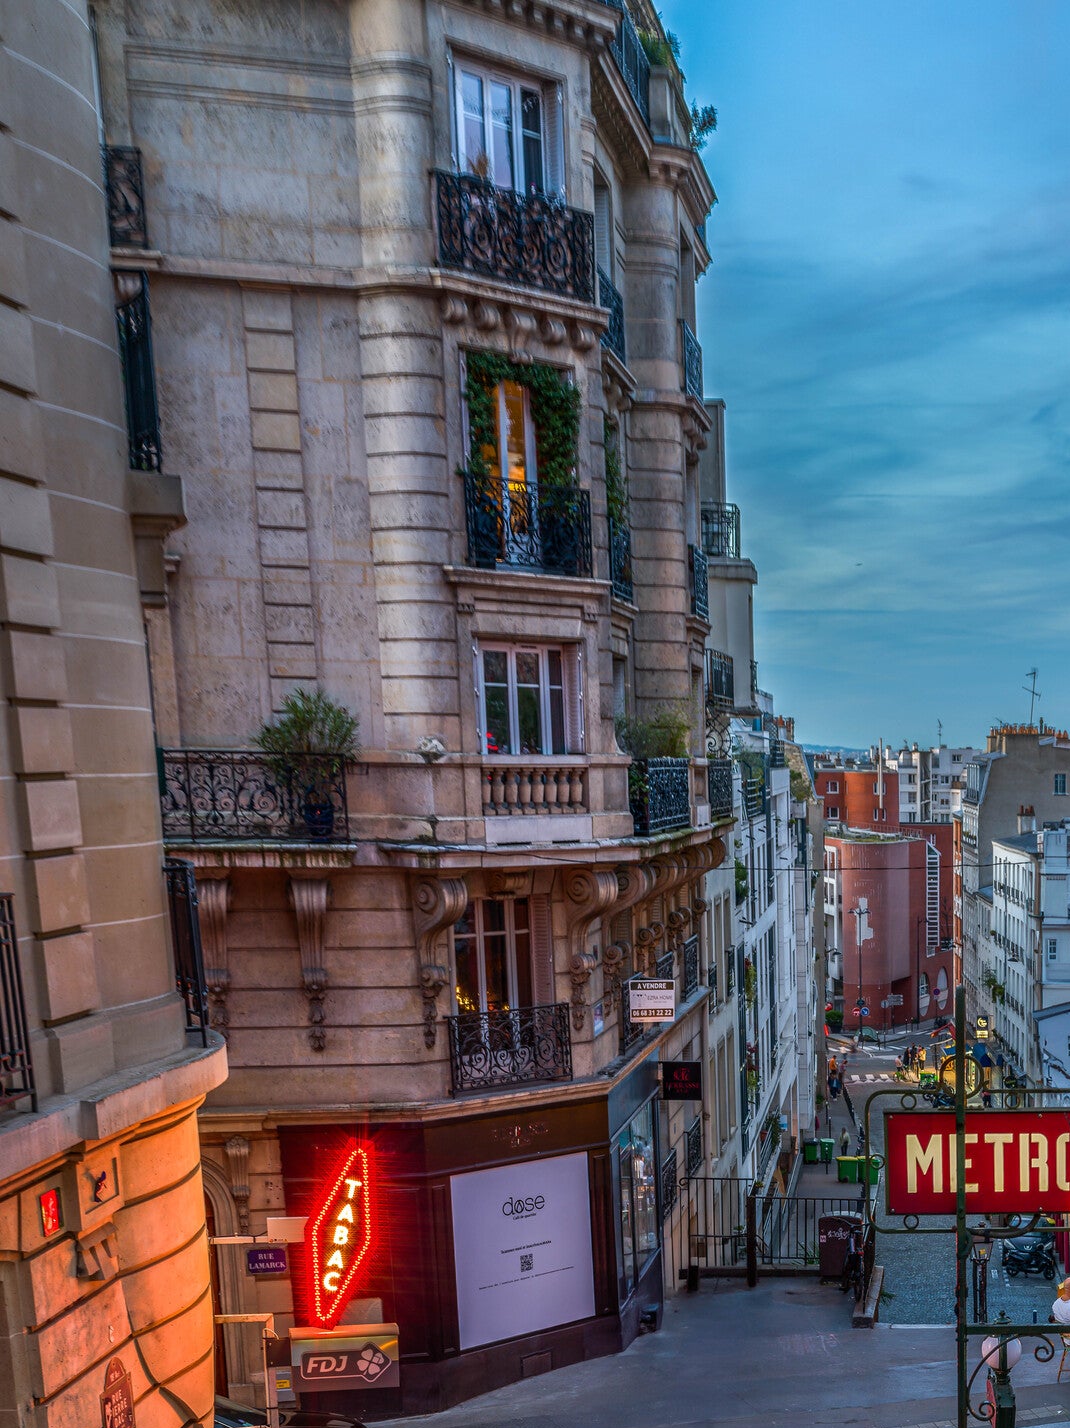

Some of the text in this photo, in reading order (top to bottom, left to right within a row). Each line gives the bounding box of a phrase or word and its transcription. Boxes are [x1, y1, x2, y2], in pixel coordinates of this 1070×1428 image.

[323, 1178, 363, 1291] TABAC
[249, 1261, 286, 1270] LAMARCK
[306, 1355, 348, 1374] FDJ
